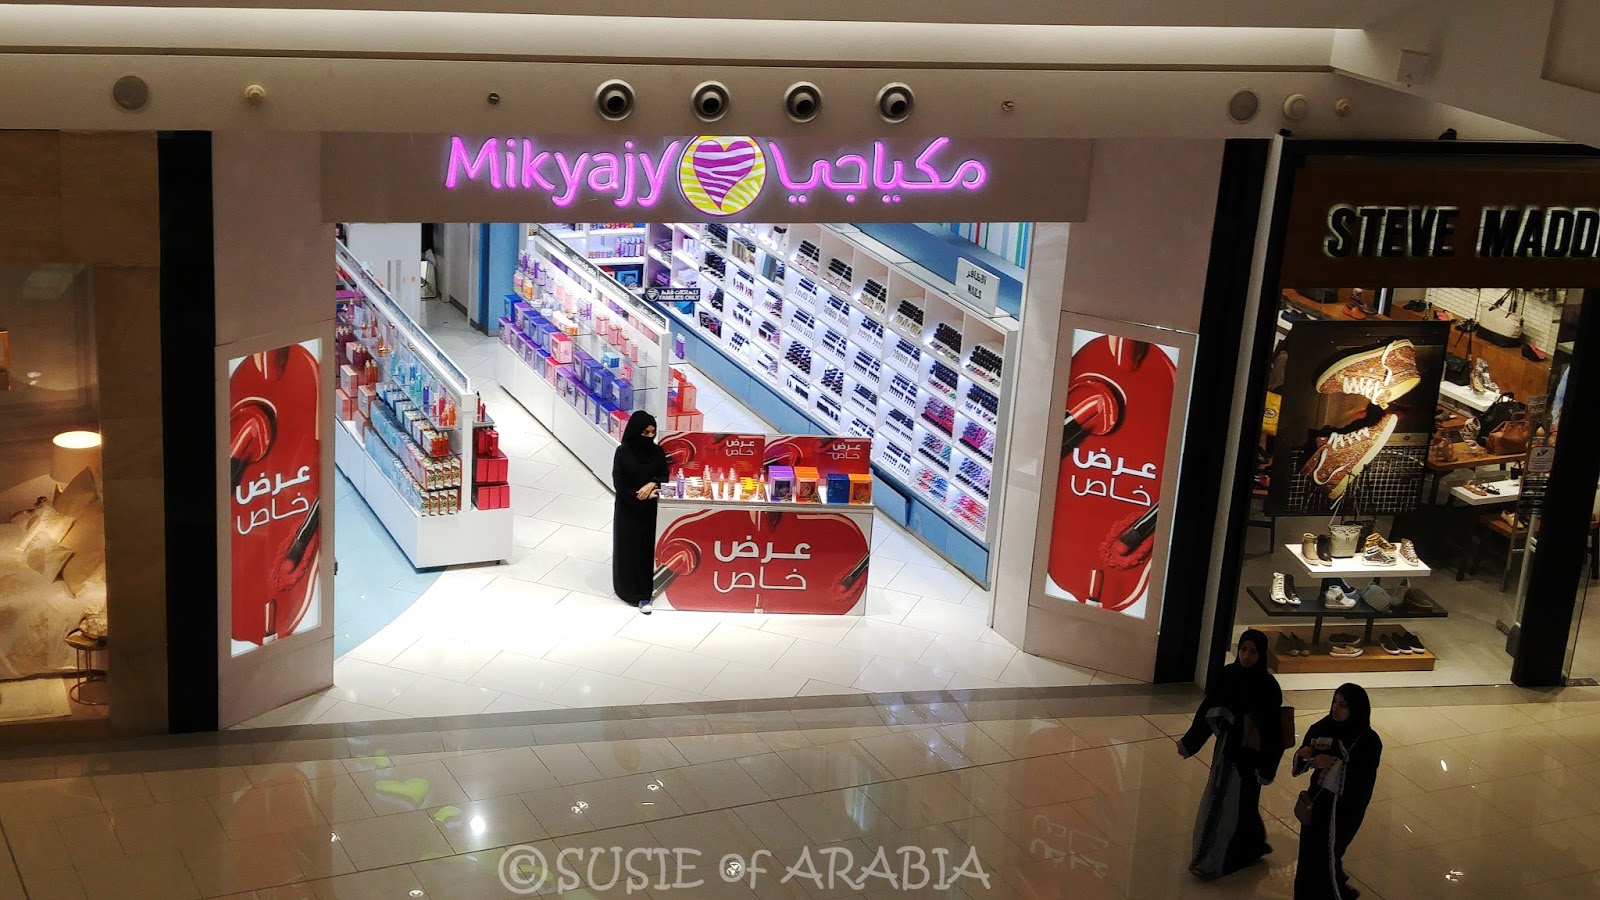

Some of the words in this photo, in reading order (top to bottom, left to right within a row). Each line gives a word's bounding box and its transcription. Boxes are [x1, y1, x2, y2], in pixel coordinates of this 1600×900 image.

[445, 136, 681, 207] Mikyajy
[769, 136, 988, 204] مكياجي
[1323, 203, 1459, 258] STEVE
[1475, 206, 1600, 258] MADD
[1072, 447, 1157, 480] عرض
[236, 465, 310, 505] عرض
[1071, 474, 1151, 506] خاص
[237, 492, 309, 535] خاص
[714, 535, 812, 563] عرض
[713, 565, 807, 594] خاص
